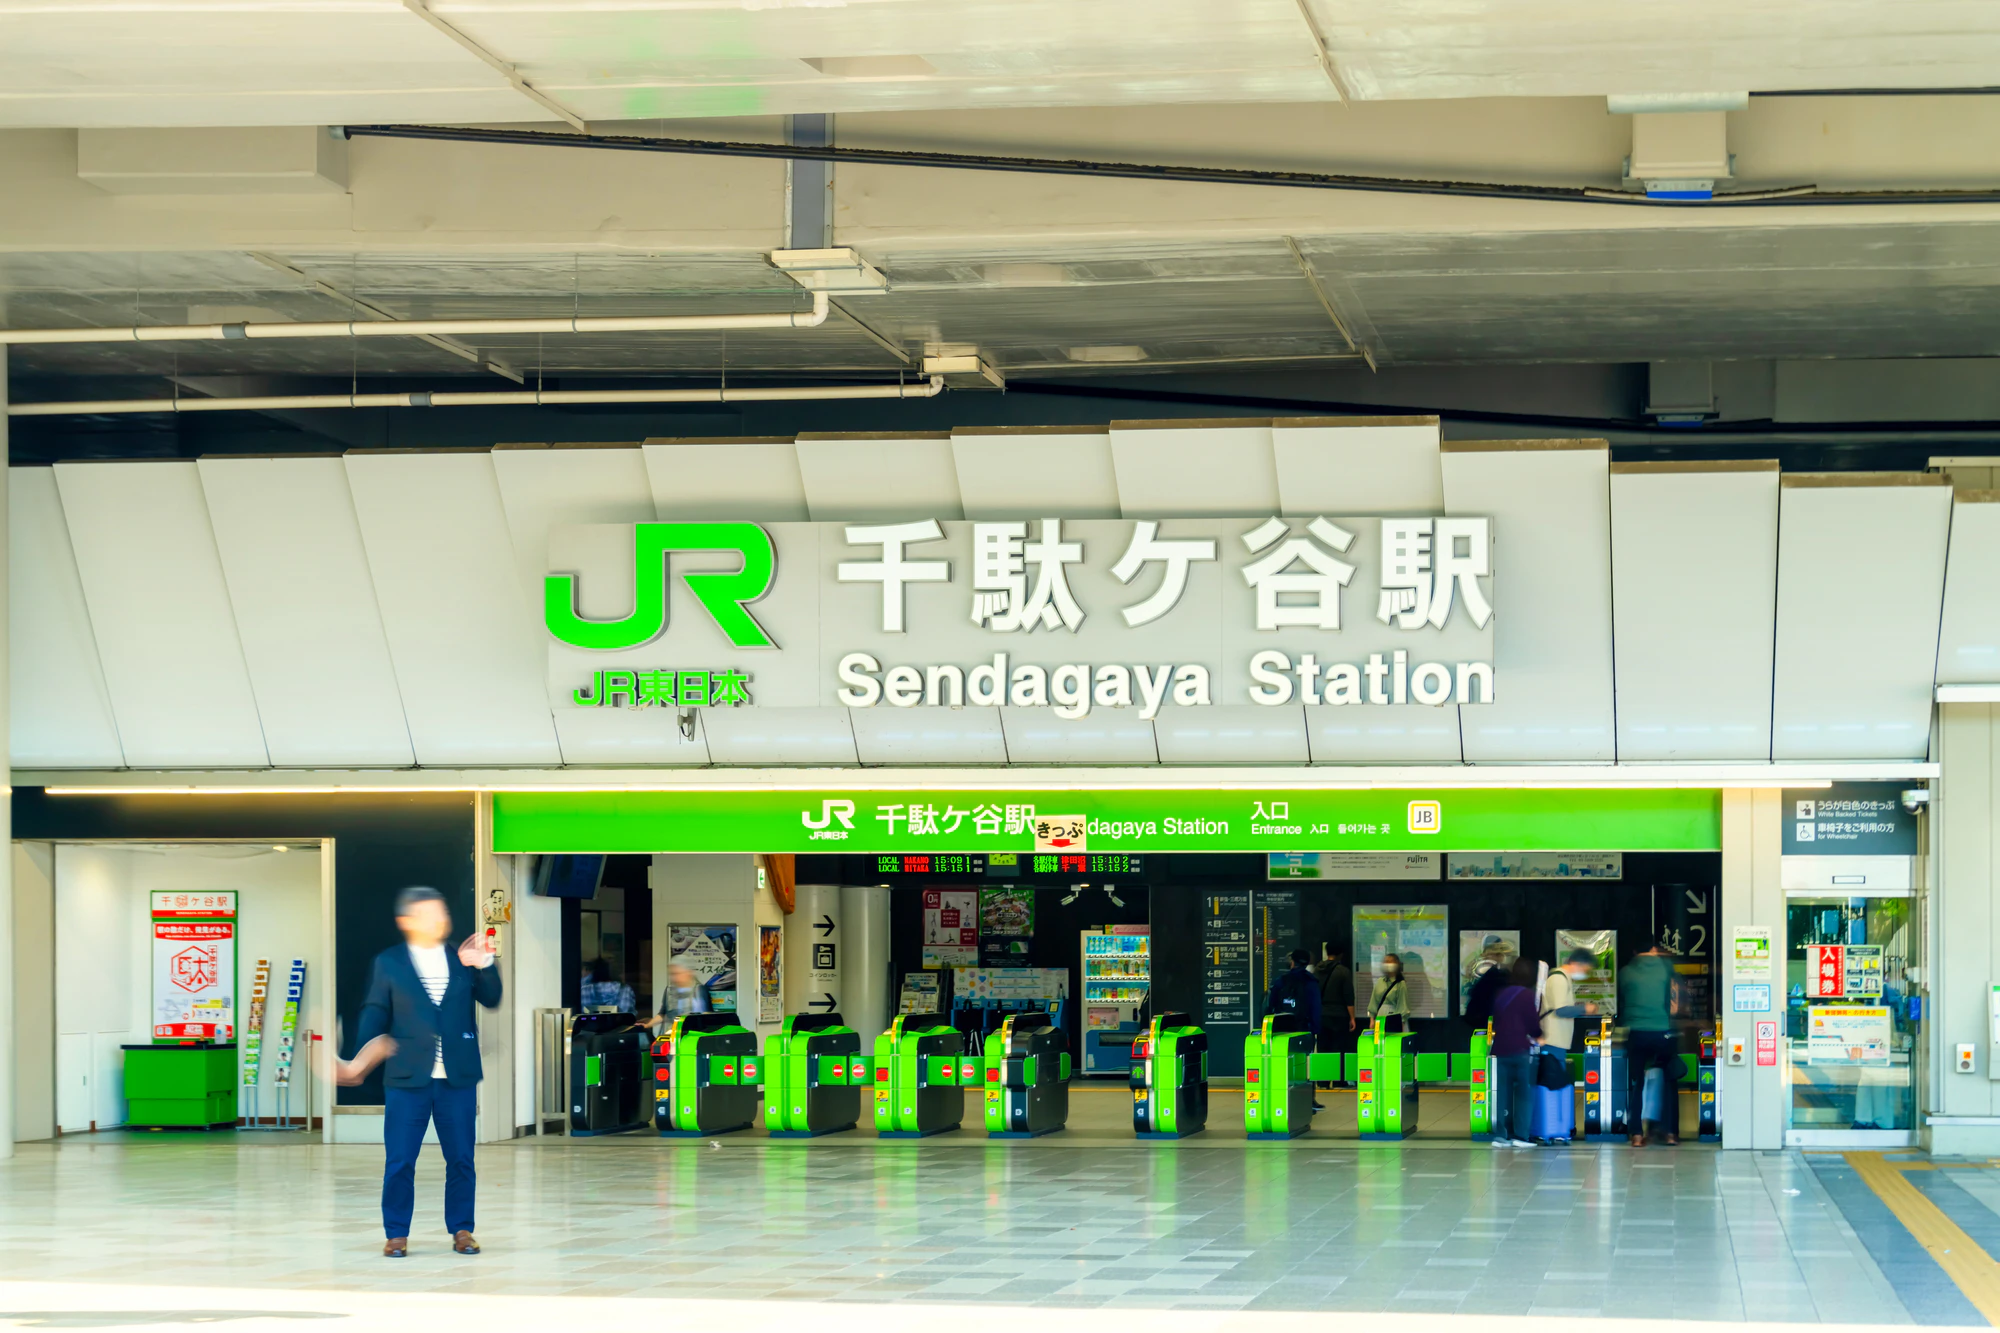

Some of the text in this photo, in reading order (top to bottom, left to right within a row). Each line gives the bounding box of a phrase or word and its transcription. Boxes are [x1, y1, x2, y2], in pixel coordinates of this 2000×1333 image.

[837, 516, 1494, 633] 千駄ケ谷駅
[545, 521, 776, 649] JR
[573, 669, 751, 706] JR東日本
[837, 650, 1494, 720] Sendagaya Station
[1250, 801, 1289, 820] 入口
[1818, 800, 1895, 811] うらが白色のきっぷ
[802, 799, 855, 829] JR
[875, 804, 1035, 835] 千駄ケ谷駅
[1416, 810, 1433, 823] JB
[1037, 821, 1084, 838] きっぷ
[1088, 817, 1229, 838] dagaya Station
[1252, 824, 1302, 835] Entrance
[1310, 824, 1329, 834] 入口
[1338, 824, 1391, 834] 들어가는 곳
[1818, 823, 1895, 833] 車椅子をご利用の方
[808, 831, 849, 840] JR東日本
[878, 856, 900, 864] LOCAL
[904, 856, 930, 864] NAKANO
[935, 856, 963, 864] 15:09
[966, 856, 971, 864] 1
[1091, 855, 1120, 864] 15:10
[1122, 855, 1129, 864] 2
[878, 864, 900, 872] LOCAL
[935, 864, 963, 872] 15:15
[966, 864, 971, 872] 1
[1091, 864, 1120, 872] 15:15
[1122, 864, 1129, 872] 2
[1206, 897, 1212, 907] 1
[1688, 925, 1707, 956] 2
[1206, 946, 1213, 958] 2
[1821, 947, 1836, 994] 入場券
